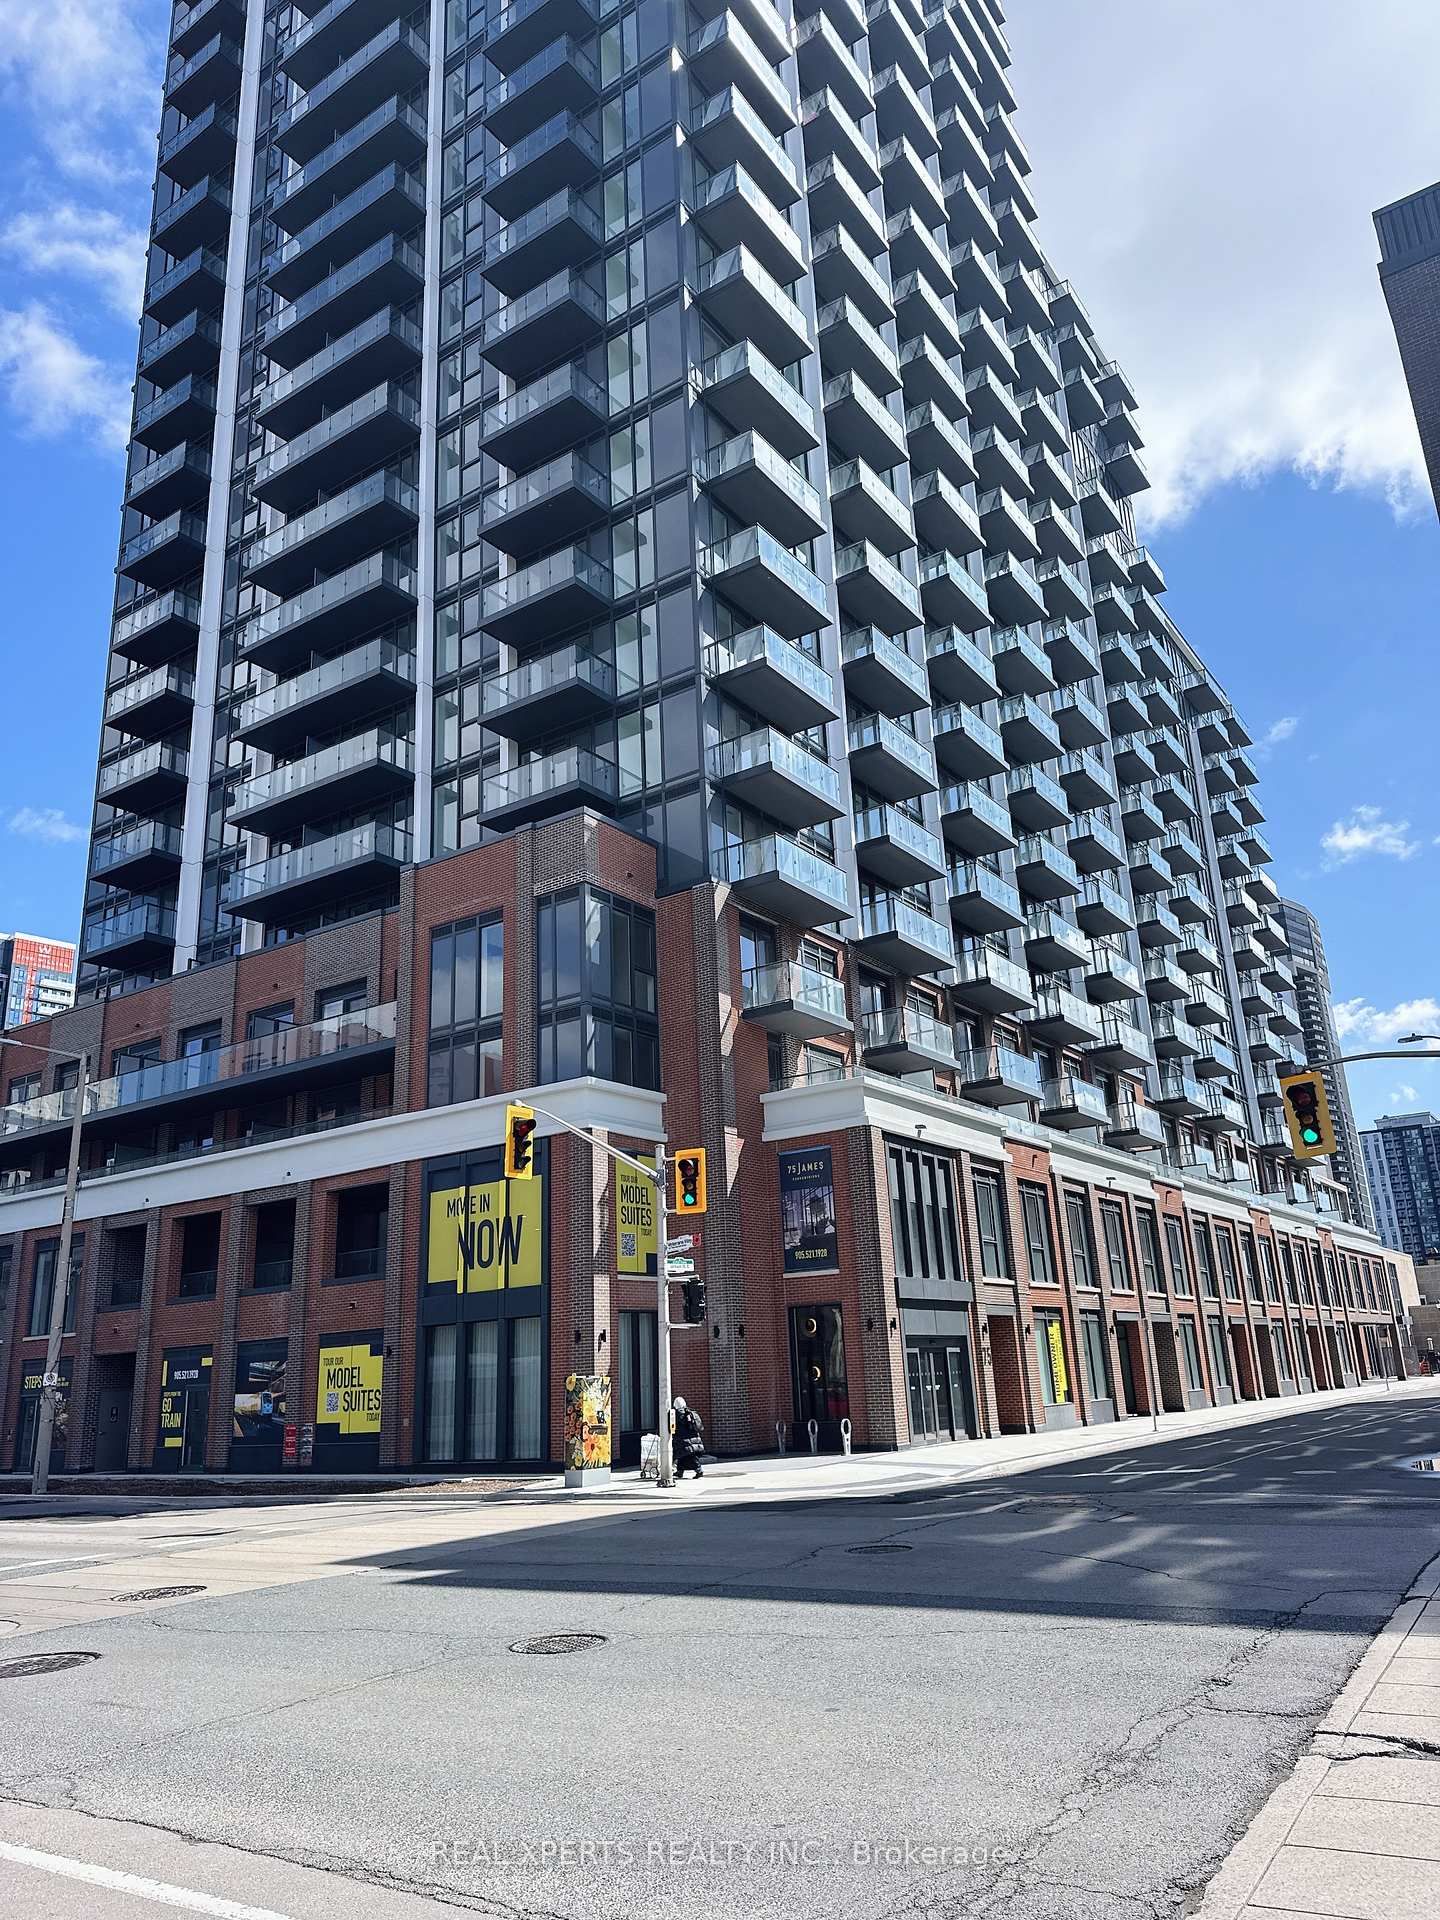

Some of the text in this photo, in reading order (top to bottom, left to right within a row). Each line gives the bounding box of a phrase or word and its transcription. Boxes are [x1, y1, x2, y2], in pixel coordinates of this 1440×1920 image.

[787, 1161, 824, 1175] 75 JAMES
[479, 1193, 490, 1213] IN
[620, 1184, 651, 1206] MODEL
[620, 1206, 652, 1226] SUITES
[457, 1214, 524, 1272] NOW
[323, 1357, 344, 1367] TOUR OUR
[24, 1375, 43, 1389] STEPS
[326, 1366, 364, 1389] MODEL
[162, 1398, 172, 1413] GO
[342, 1389, 381, 1412] SUITES
[161, 1413, 182, 1428] TRAIN
[366, 1413, 380, 1422] TODAY
